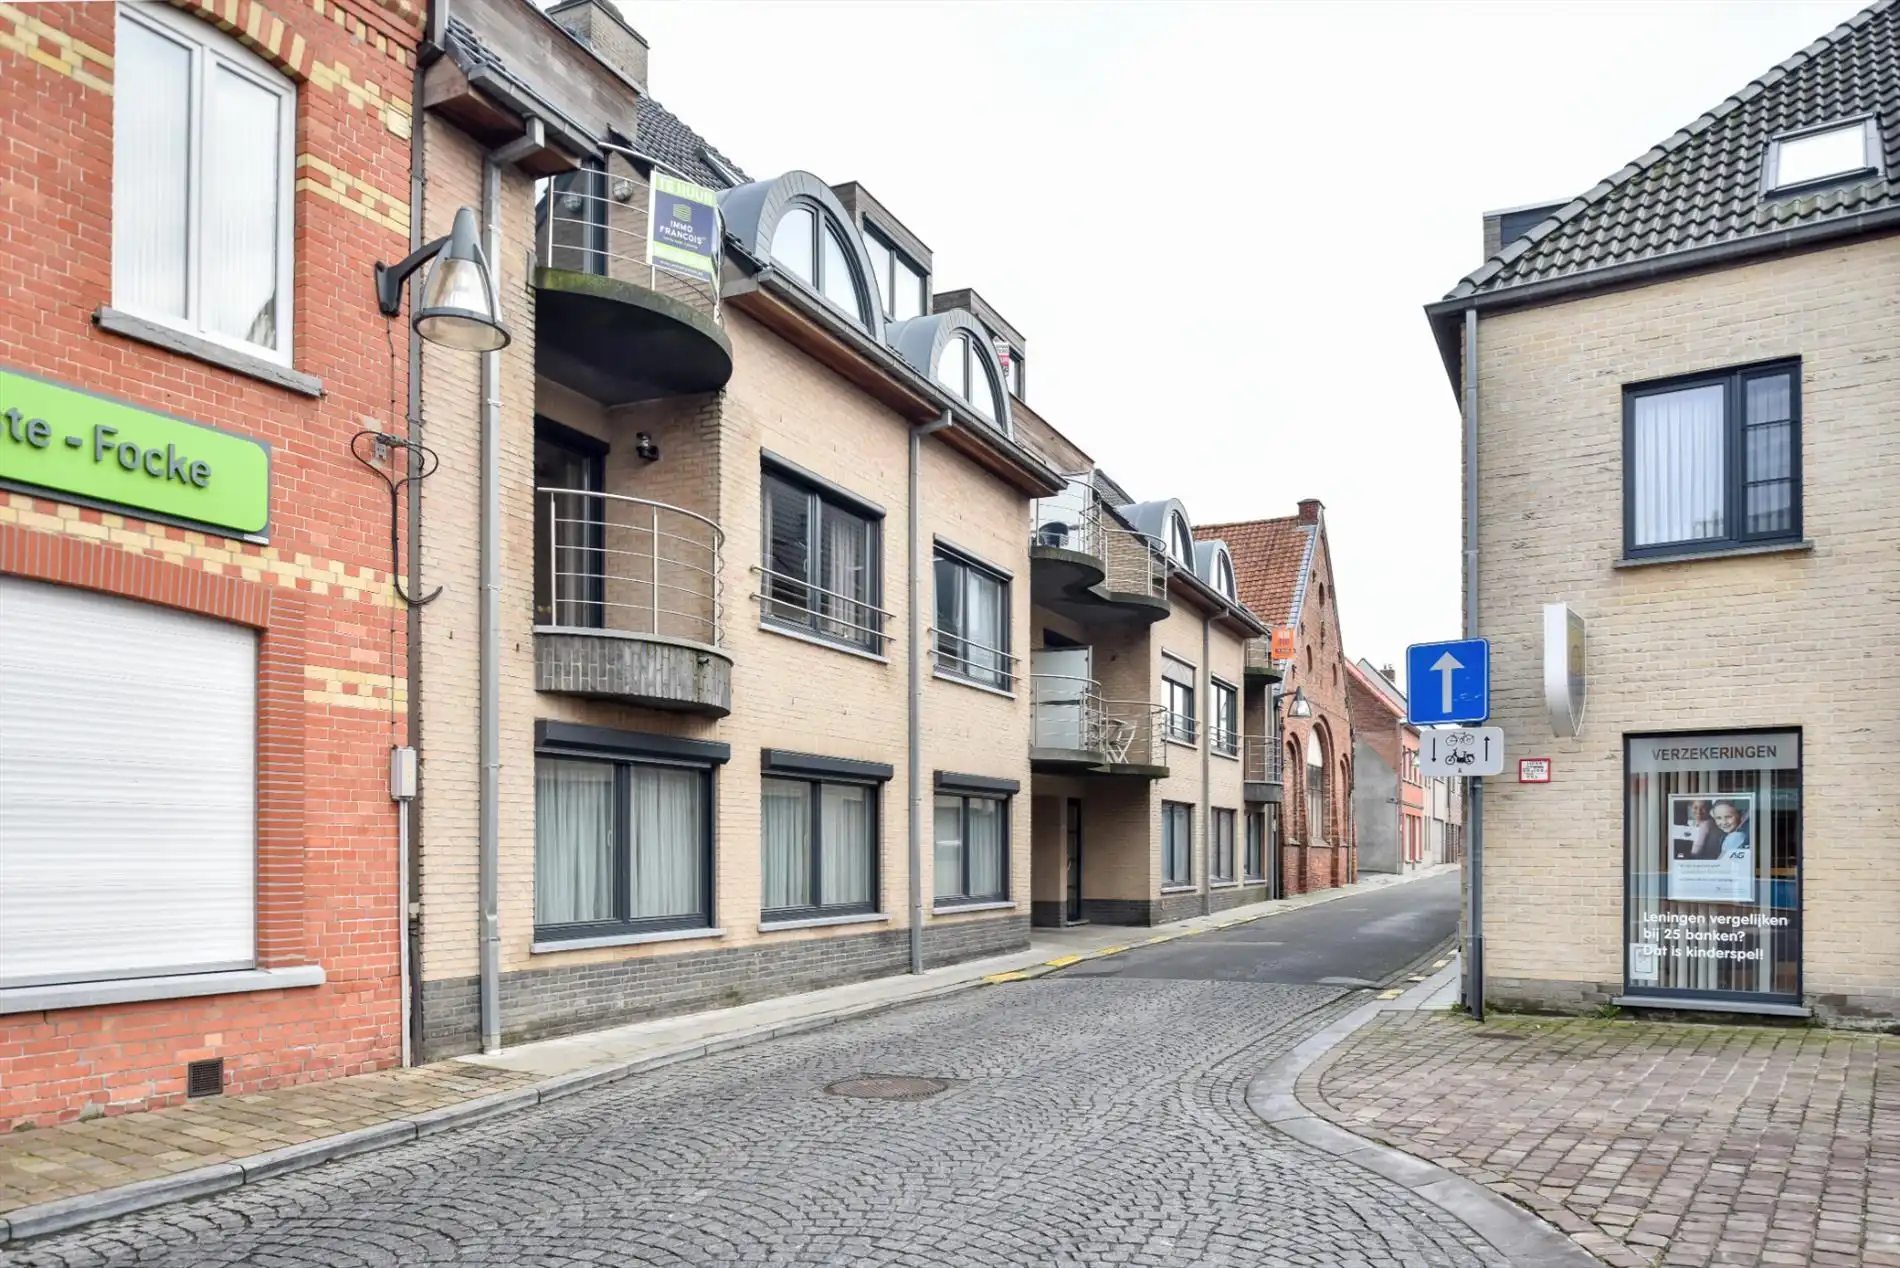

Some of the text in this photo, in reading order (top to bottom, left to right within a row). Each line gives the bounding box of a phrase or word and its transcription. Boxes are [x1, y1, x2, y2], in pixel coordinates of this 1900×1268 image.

[670, 219, 693, 233] IMMO
[0, 406, 212, 488] te - Focke
[1651, 744, 1778, 761] VERZEKERINGEN
[1643, 911, 1789, 928] Leningen vergelijken
[1643, 927, 1746, 942] bij 25 banken?
[1643, 945, 1765, 963] Dat is kinderspel!
